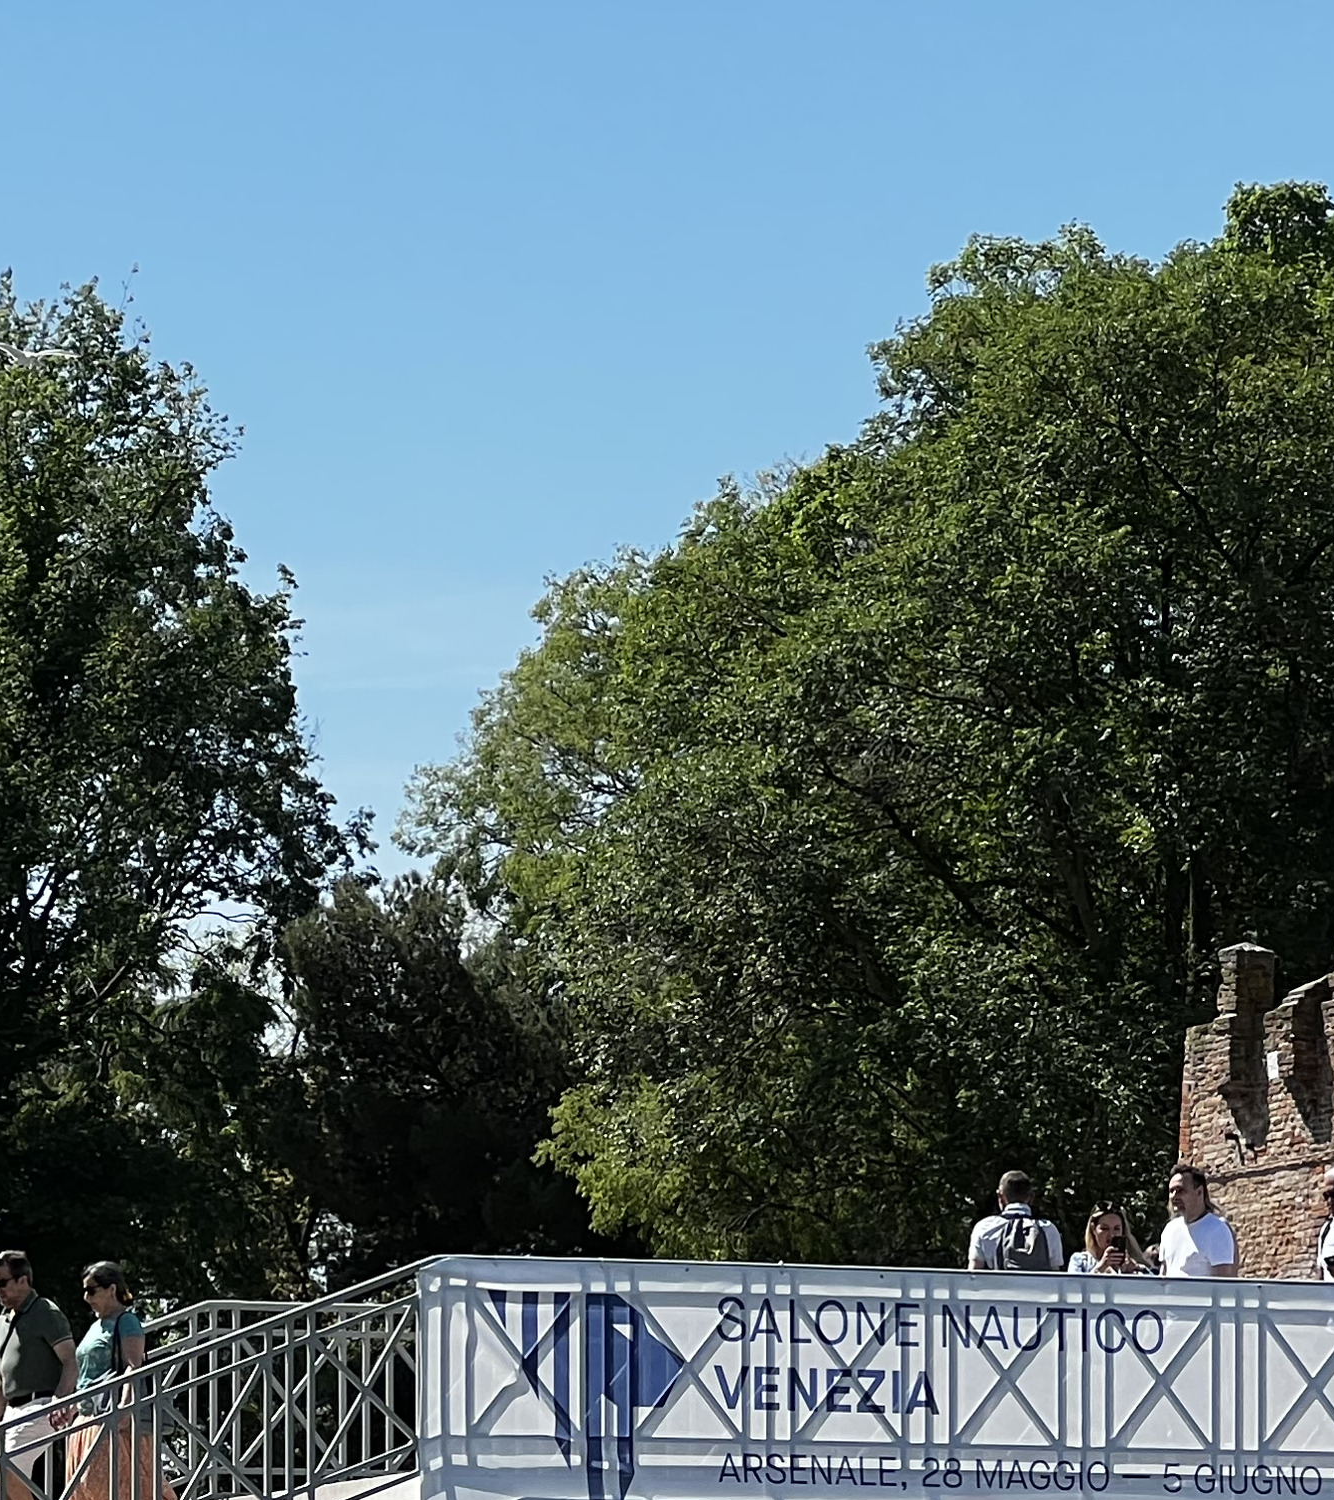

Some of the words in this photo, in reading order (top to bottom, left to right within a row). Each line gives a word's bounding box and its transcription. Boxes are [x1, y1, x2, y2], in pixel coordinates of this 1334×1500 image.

[717, 1296, 921, 1348] SALONE
[941, 1303, 1165, 1355] NAUTICO
[713, 1364, 941, 1416] VENEZIA
[718, 1452, 908, 1491] ARSENALE,
[921, 1456, 964, 1489] 28
[975, 1458, 1111, 1493] MAGGIO
[1162, 1462, 1183, 1494] 5
[1193, 1462, 1323, 1497] GIUGNO
